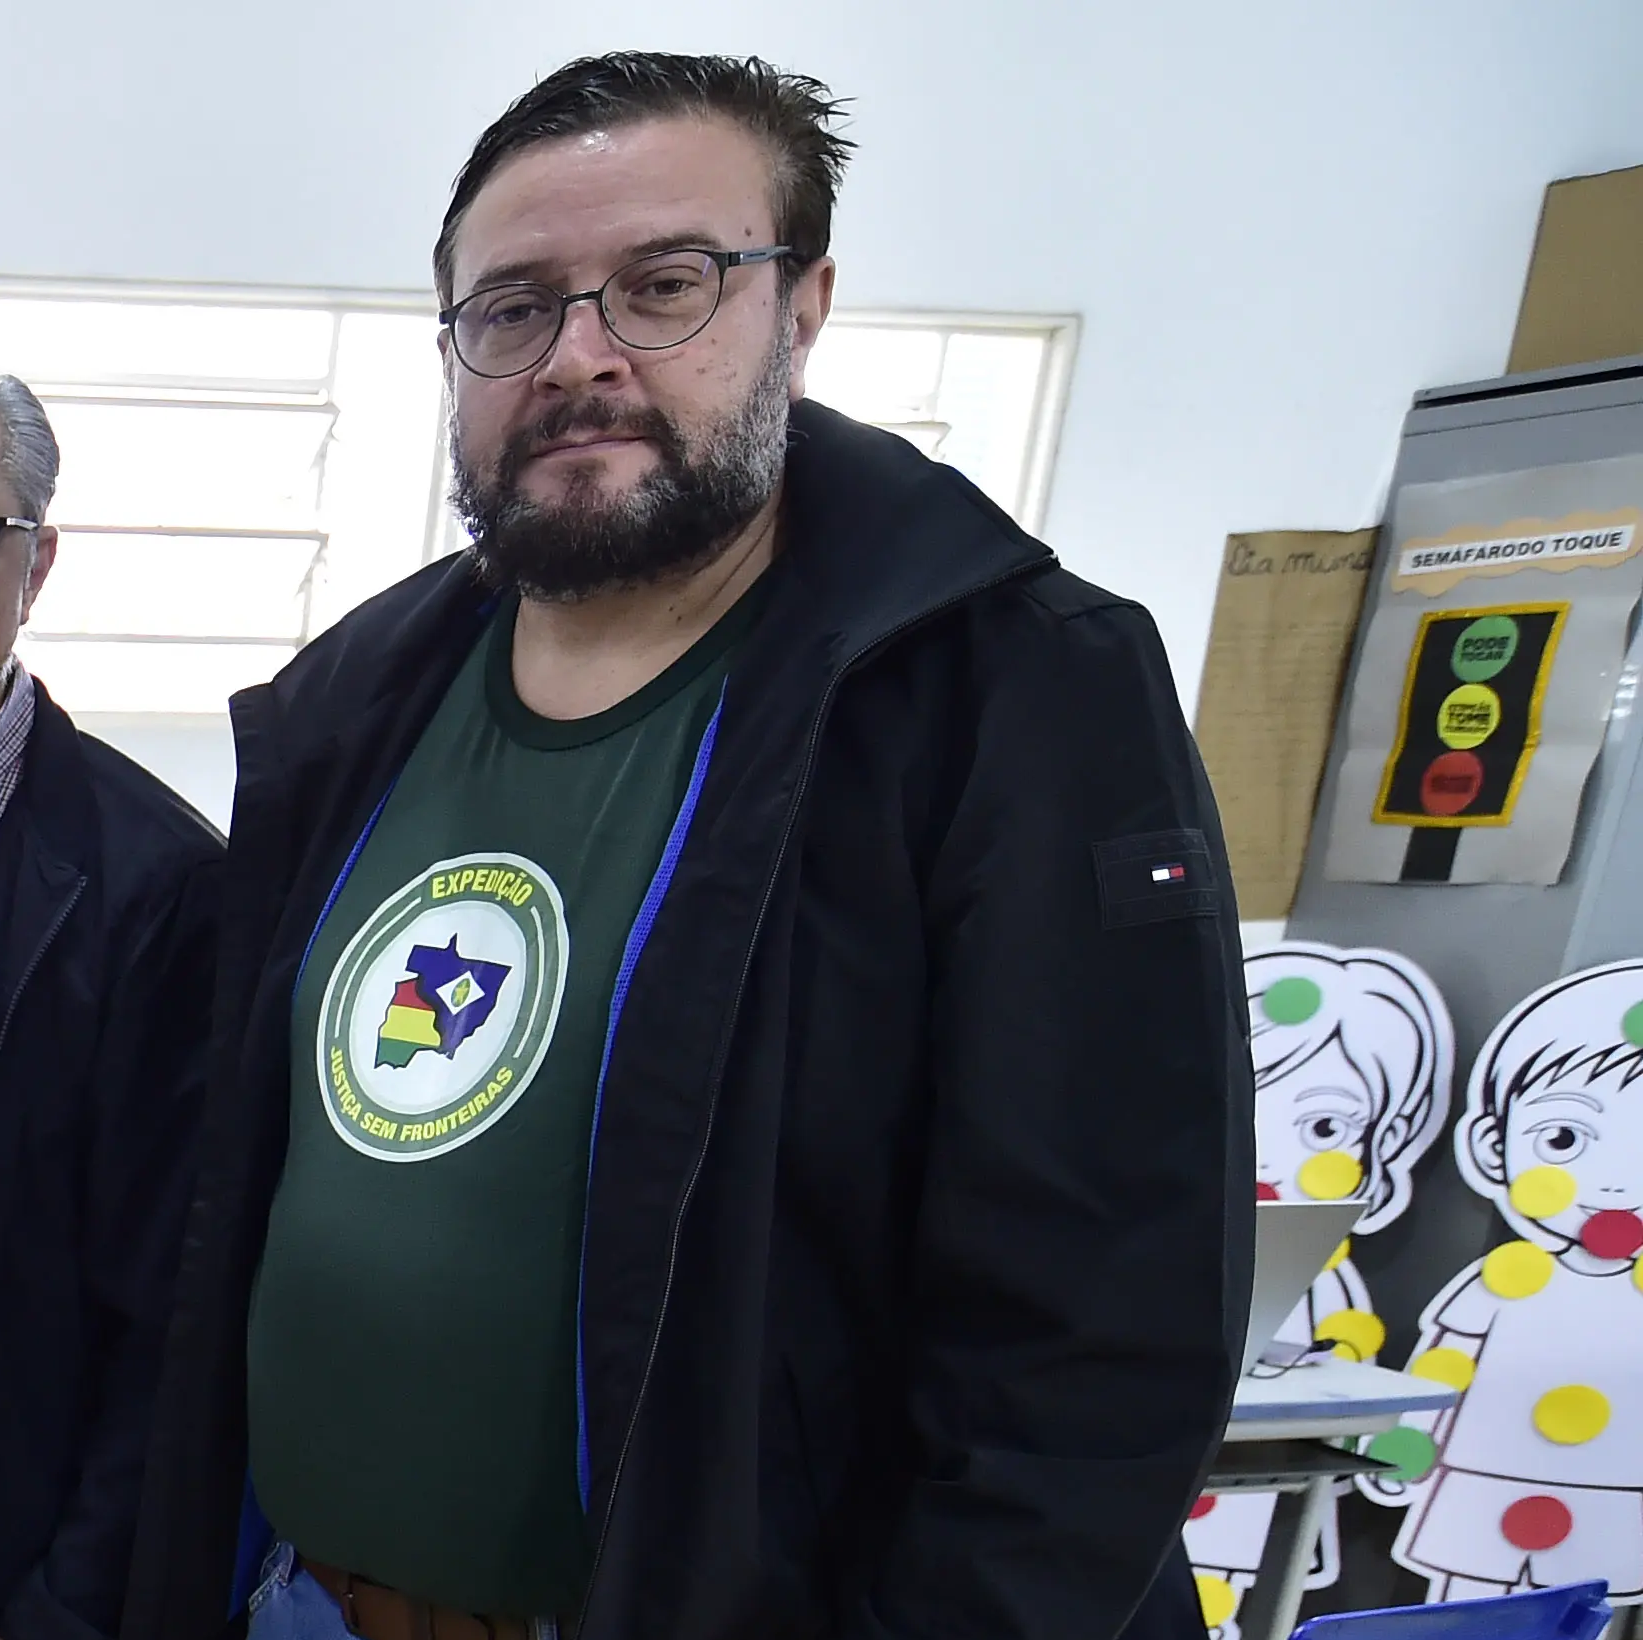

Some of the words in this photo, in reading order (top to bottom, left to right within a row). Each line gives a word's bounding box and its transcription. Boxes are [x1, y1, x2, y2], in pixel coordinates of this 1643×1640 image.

[1552, 530, 1624, 552] TOQUE
[1462, 635, 1511, 651] PODE
[432, 868, 534, 908] EXPEDIÇÃO
[330, 1045, 361, 1121] JUSTIÇA
[359, 1111, 398, 1141] SEM
[399, 1065, 514, 1143] FRONTEIRAS
